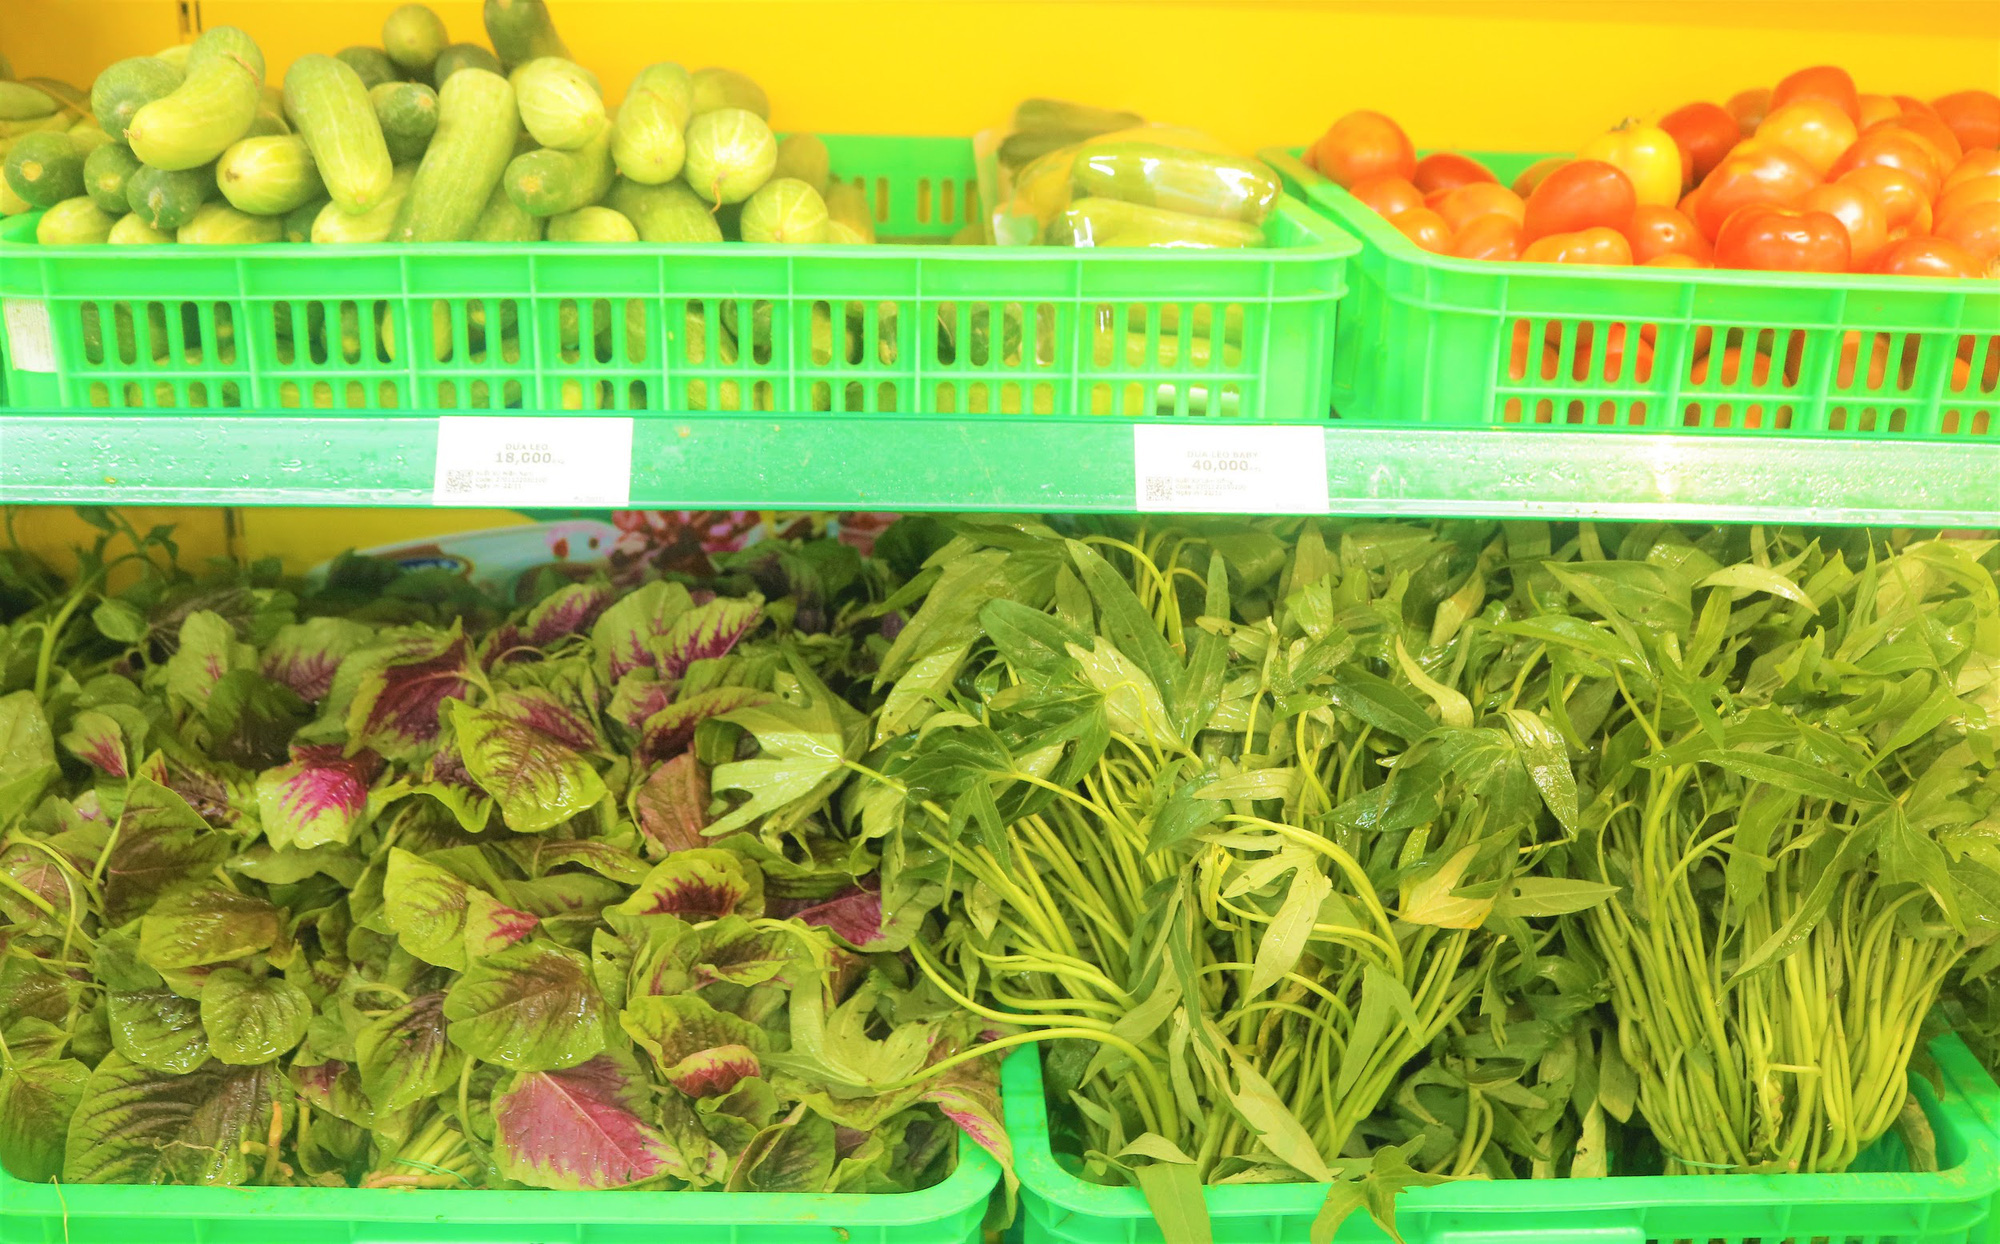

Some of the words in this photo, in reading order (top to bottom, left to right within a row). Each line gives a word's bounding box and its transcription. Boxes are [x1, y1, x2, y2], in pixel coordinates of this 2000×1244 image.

[530, 443, 548, 451] LEO
[496, 452, 552, 465] 18,000
[1233, 451, 1258, 459] BABY
[1192, 460, 1249, 473] 40,000
